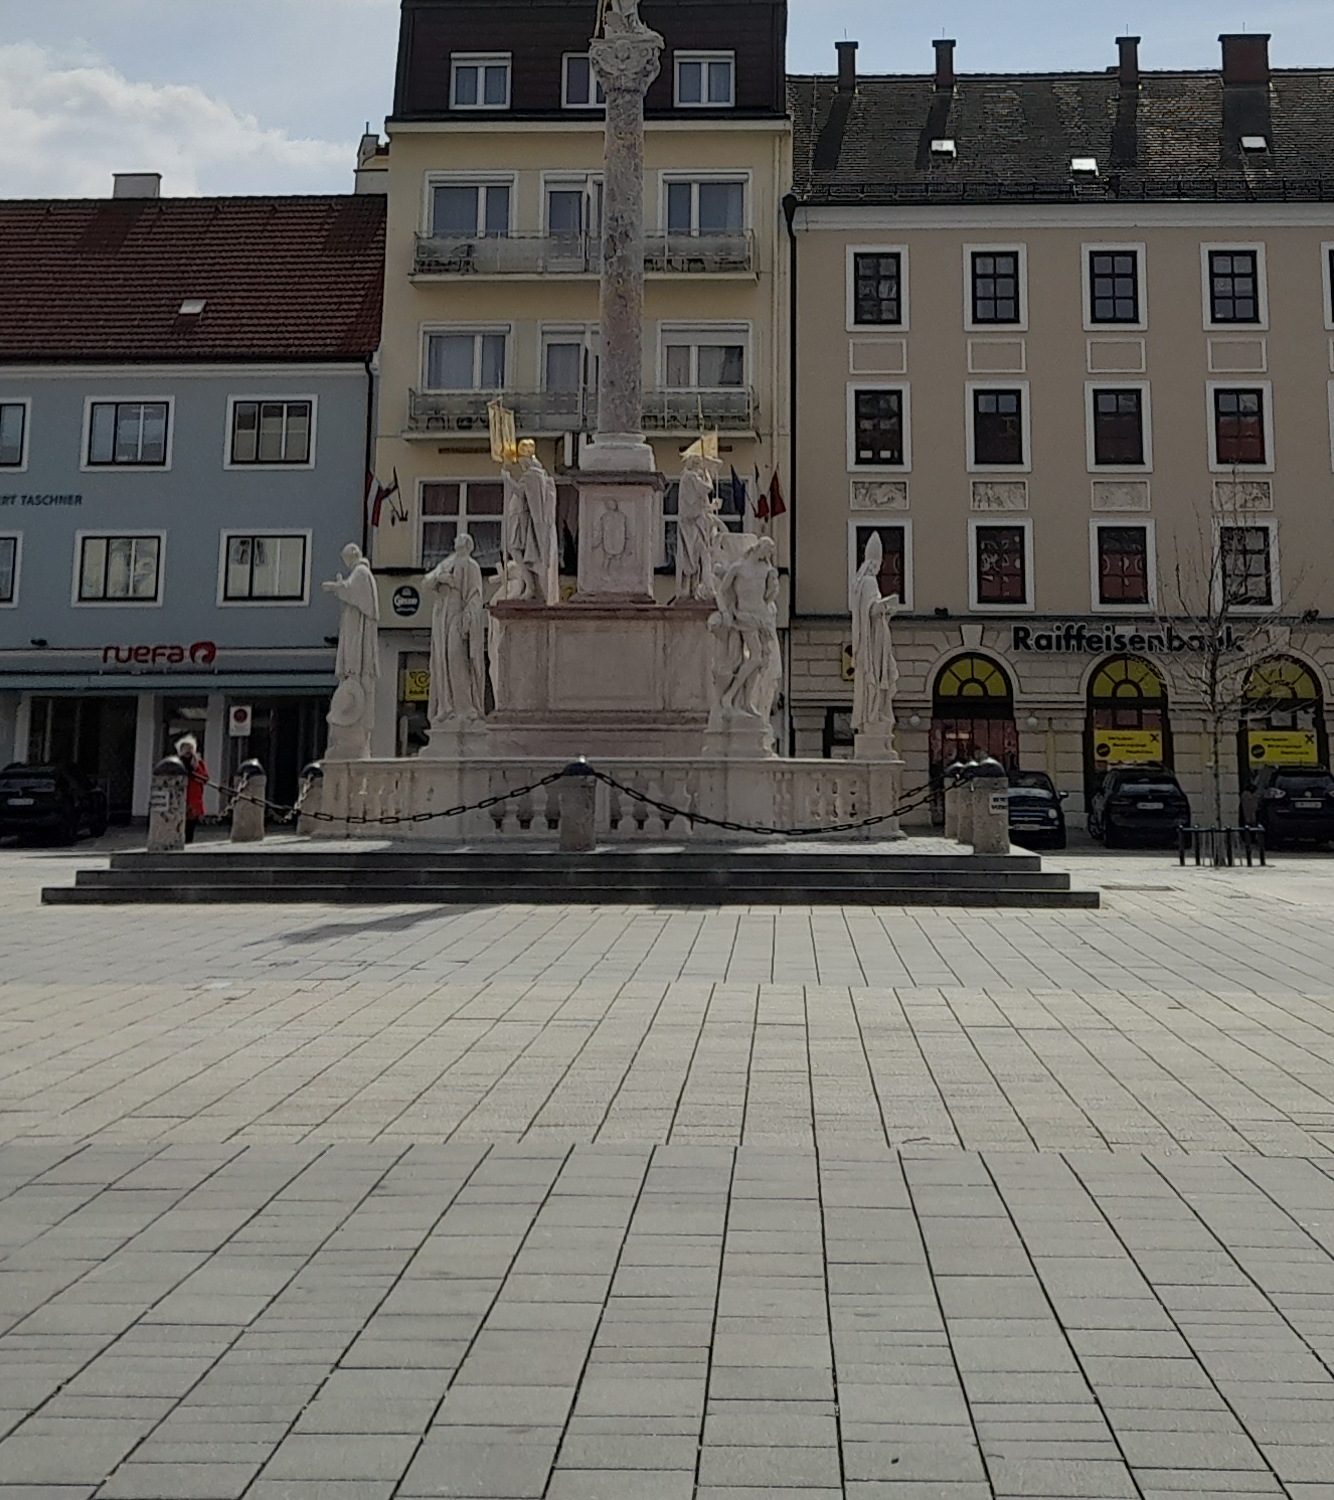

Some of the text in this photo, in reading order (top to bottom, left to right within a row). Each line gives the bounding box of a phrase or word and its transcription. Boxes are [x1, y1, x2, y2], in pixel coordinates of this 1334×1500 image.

[20, 494, 83, 506] TASCHNER
[1012, 623, 1245, 652] Raiffeisenbank
[102, 646, 185, 665] ruefa
